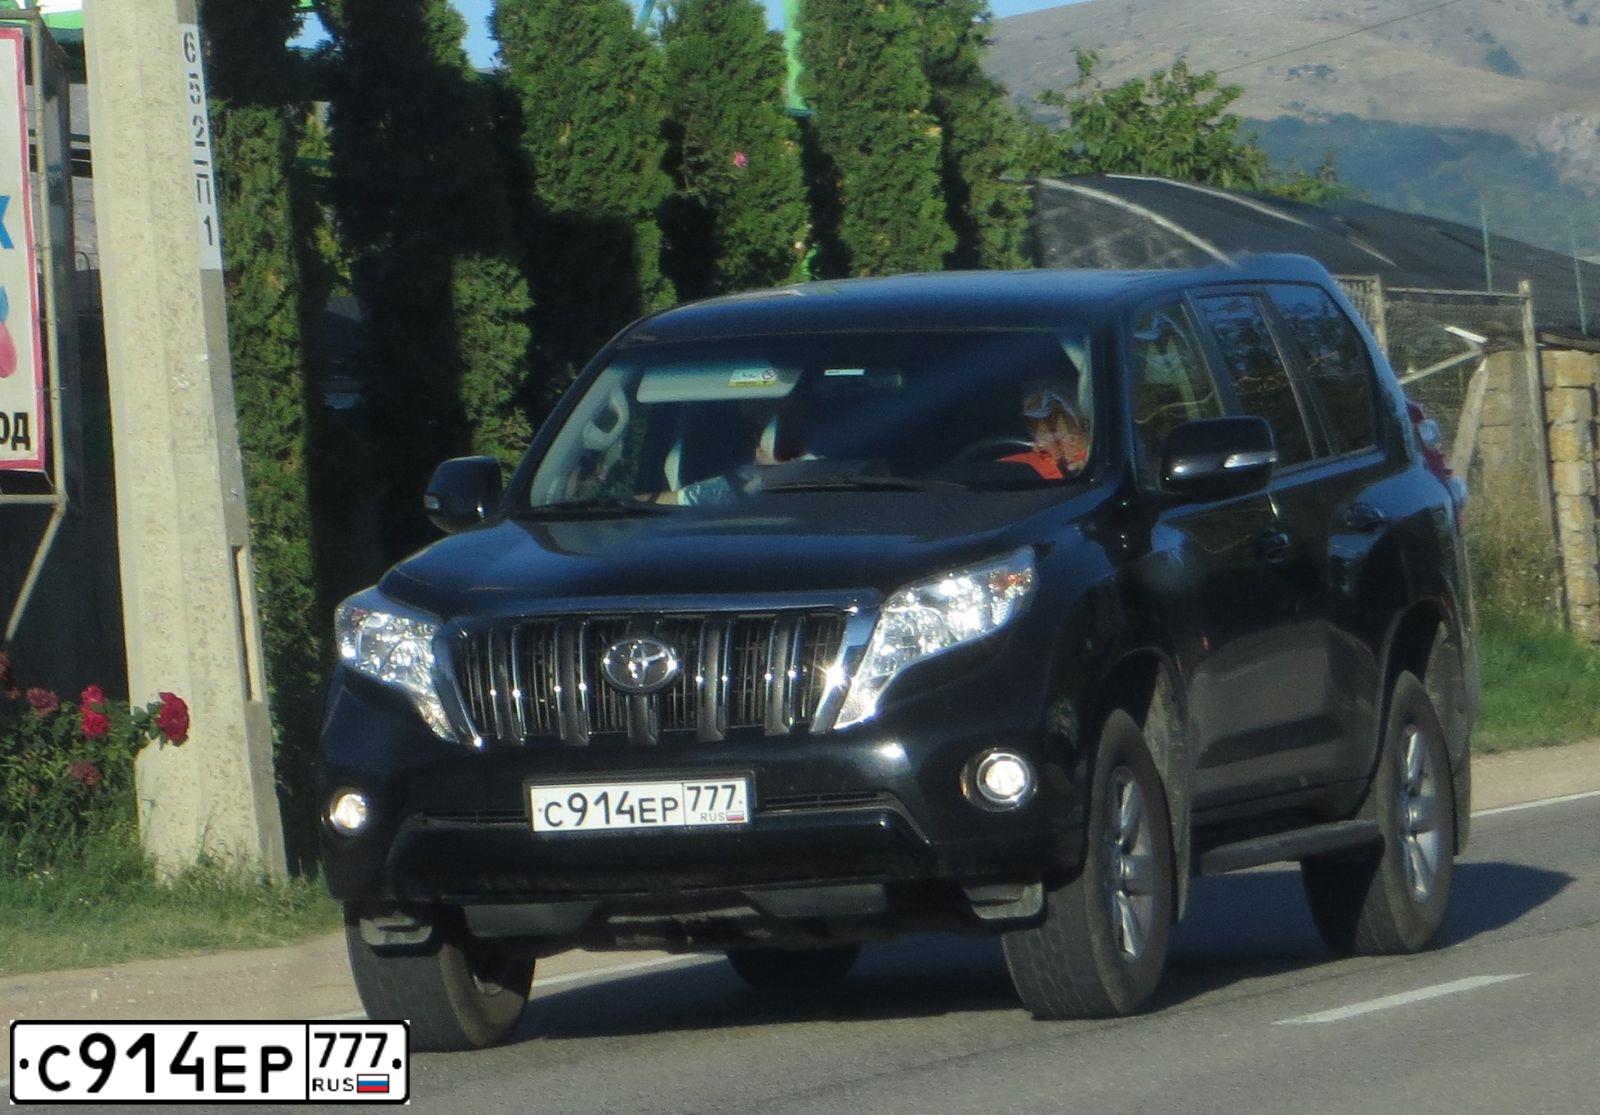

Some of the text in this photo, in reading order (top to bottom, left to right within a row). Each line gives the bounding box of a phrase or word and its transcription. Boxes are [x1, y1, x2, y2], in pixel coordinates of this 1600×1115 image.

[544, 784, 736, 828] С914ЕР 777
[700, 812, 725, 822] RUS
